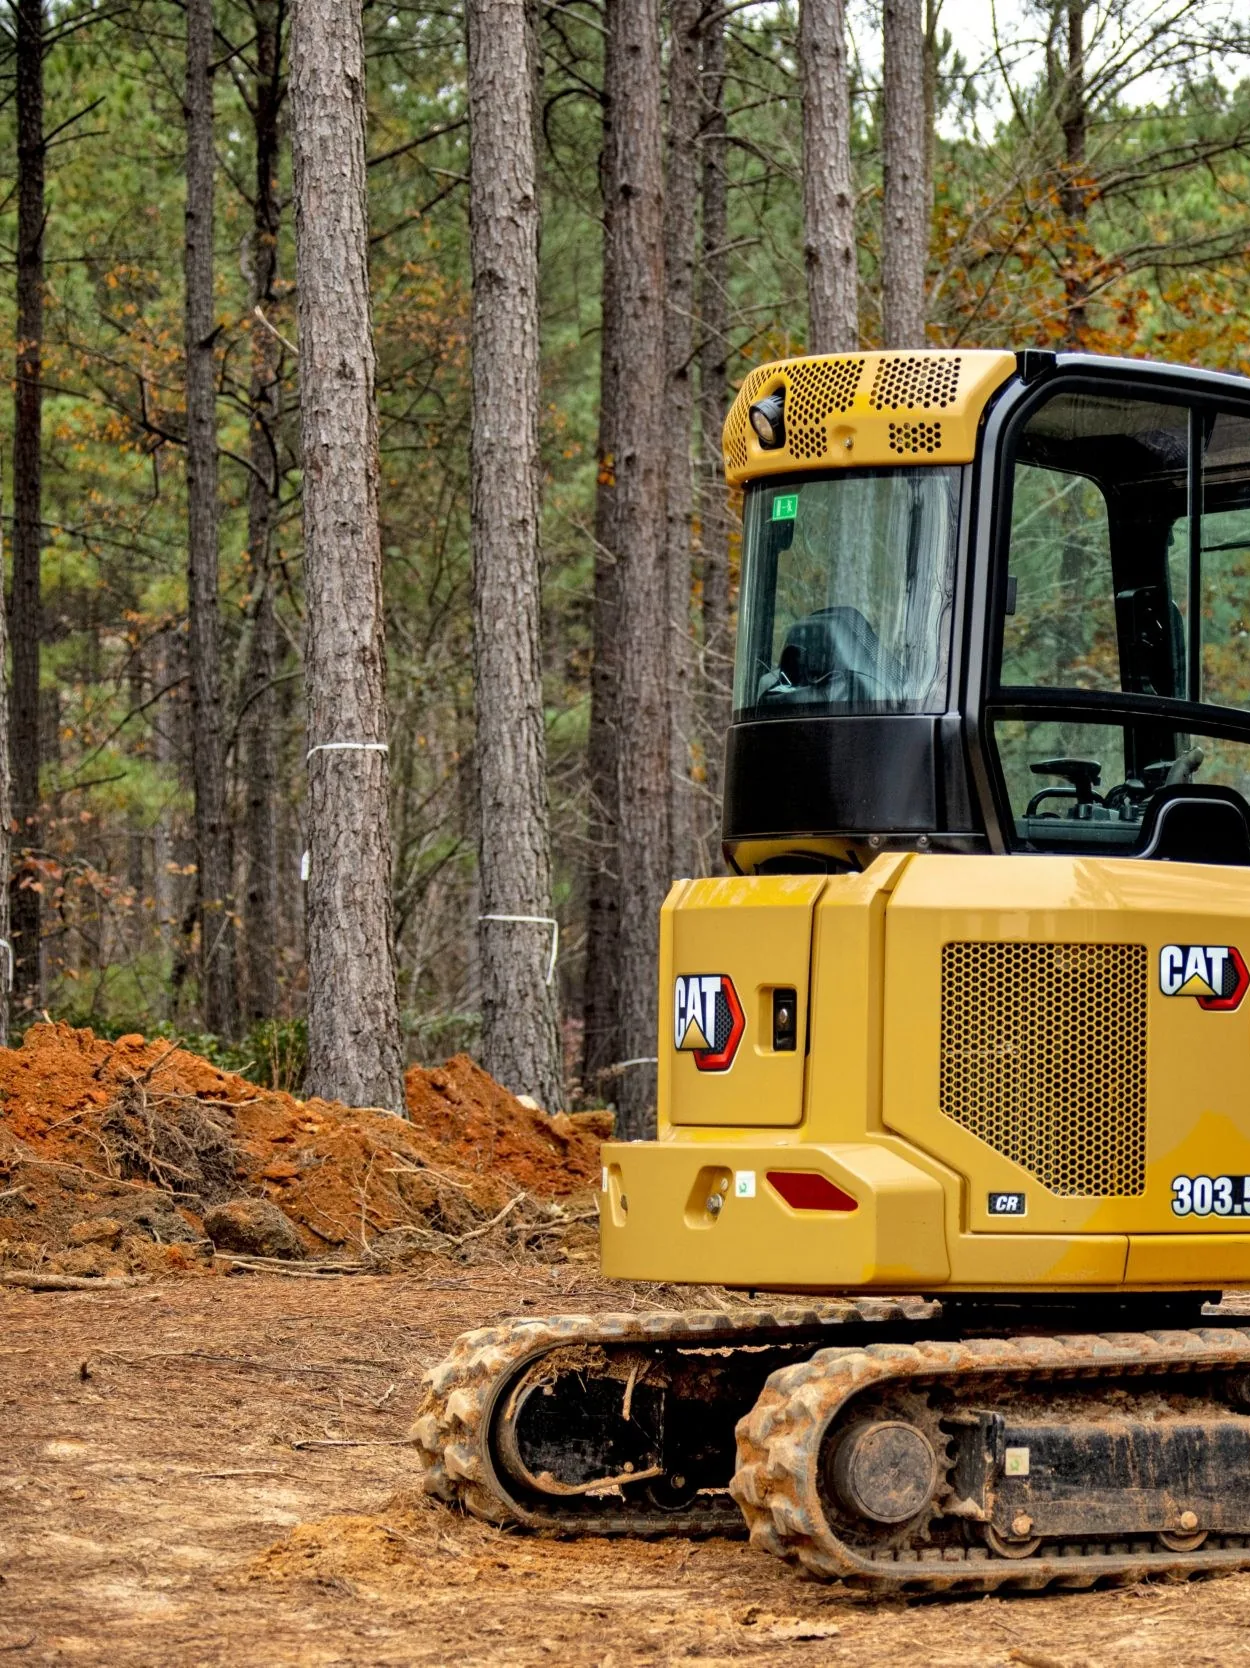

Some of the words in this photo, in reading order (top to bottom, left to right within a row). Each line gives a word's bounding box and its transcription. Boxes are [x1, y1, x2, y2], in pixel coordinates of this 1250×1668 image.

[1160, 945, 1229, 996] CAT
[675, 976, 721, 1049] CAT
[995, 1195, 1019, 1211] CR
